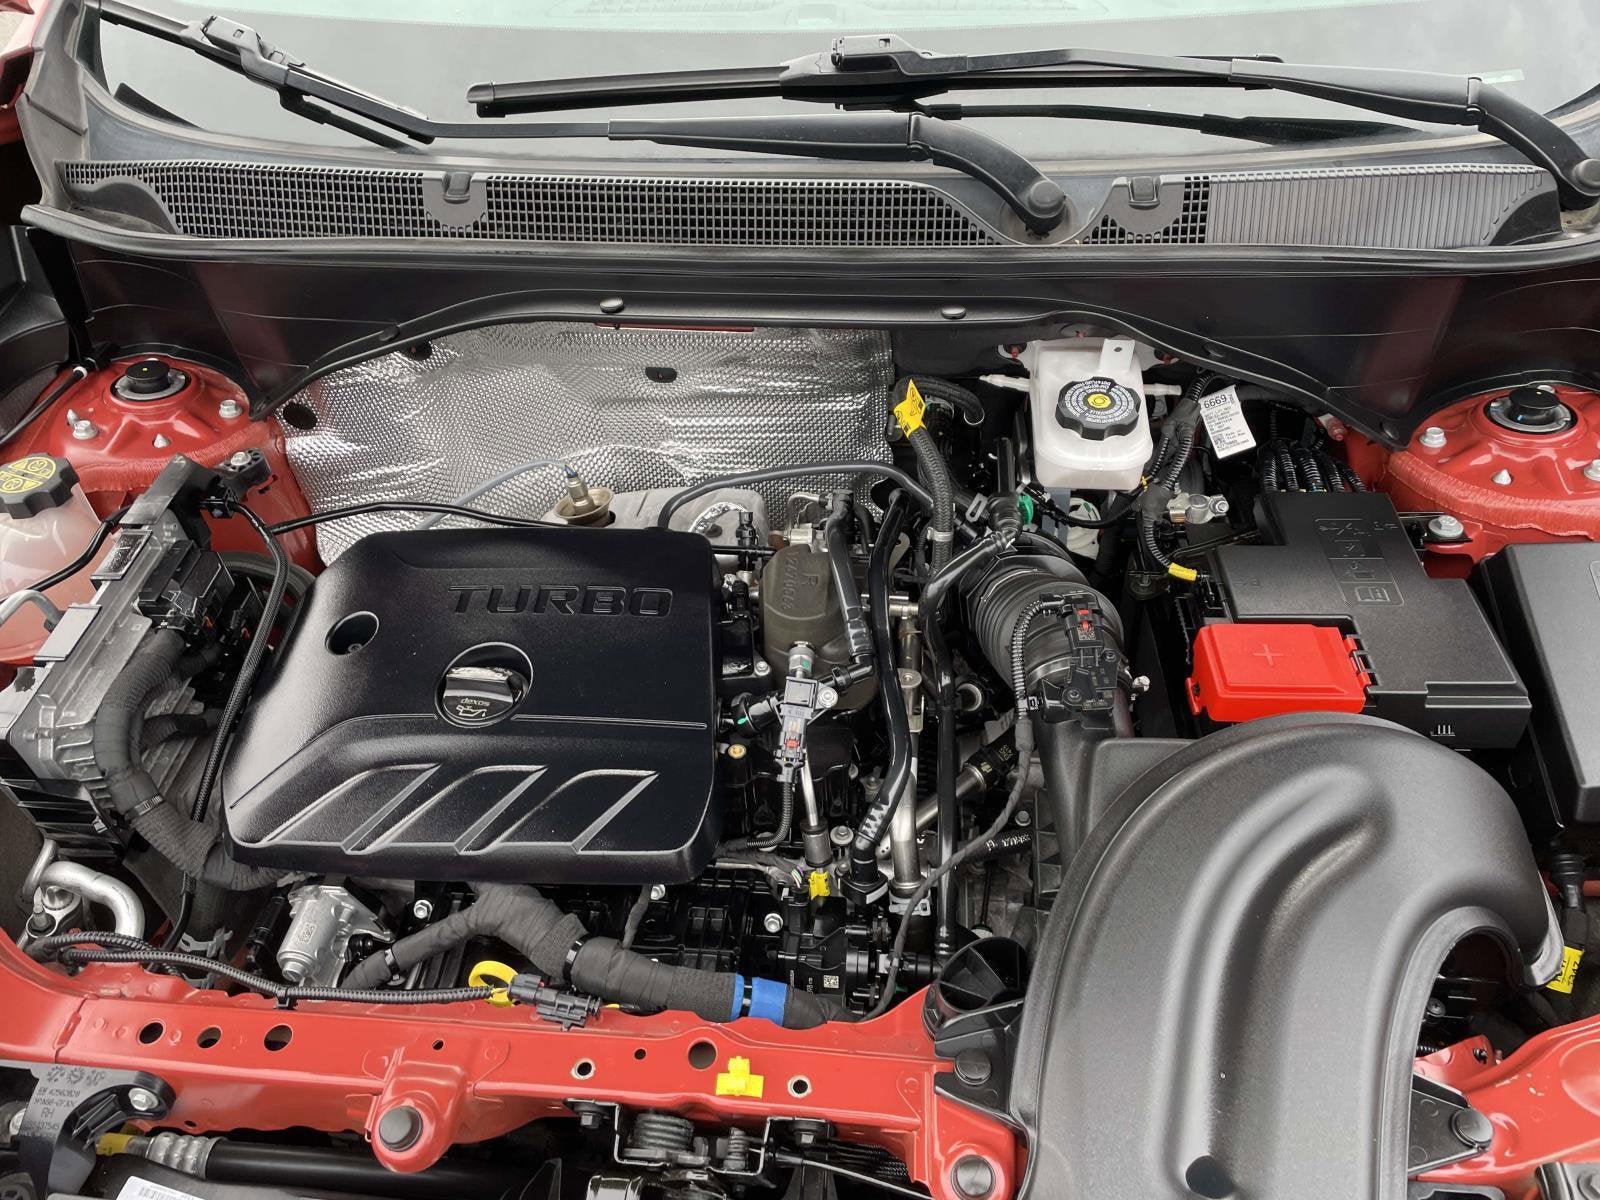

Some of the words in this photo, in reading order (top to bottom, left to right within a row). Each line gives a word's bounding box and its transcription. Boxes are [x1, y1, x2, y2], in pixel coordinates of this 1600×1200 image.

[1203, 394, 1228, 409] 6669
[448, 584, 673, 617] TURBO
[460, 697, 490, 707] dexos
